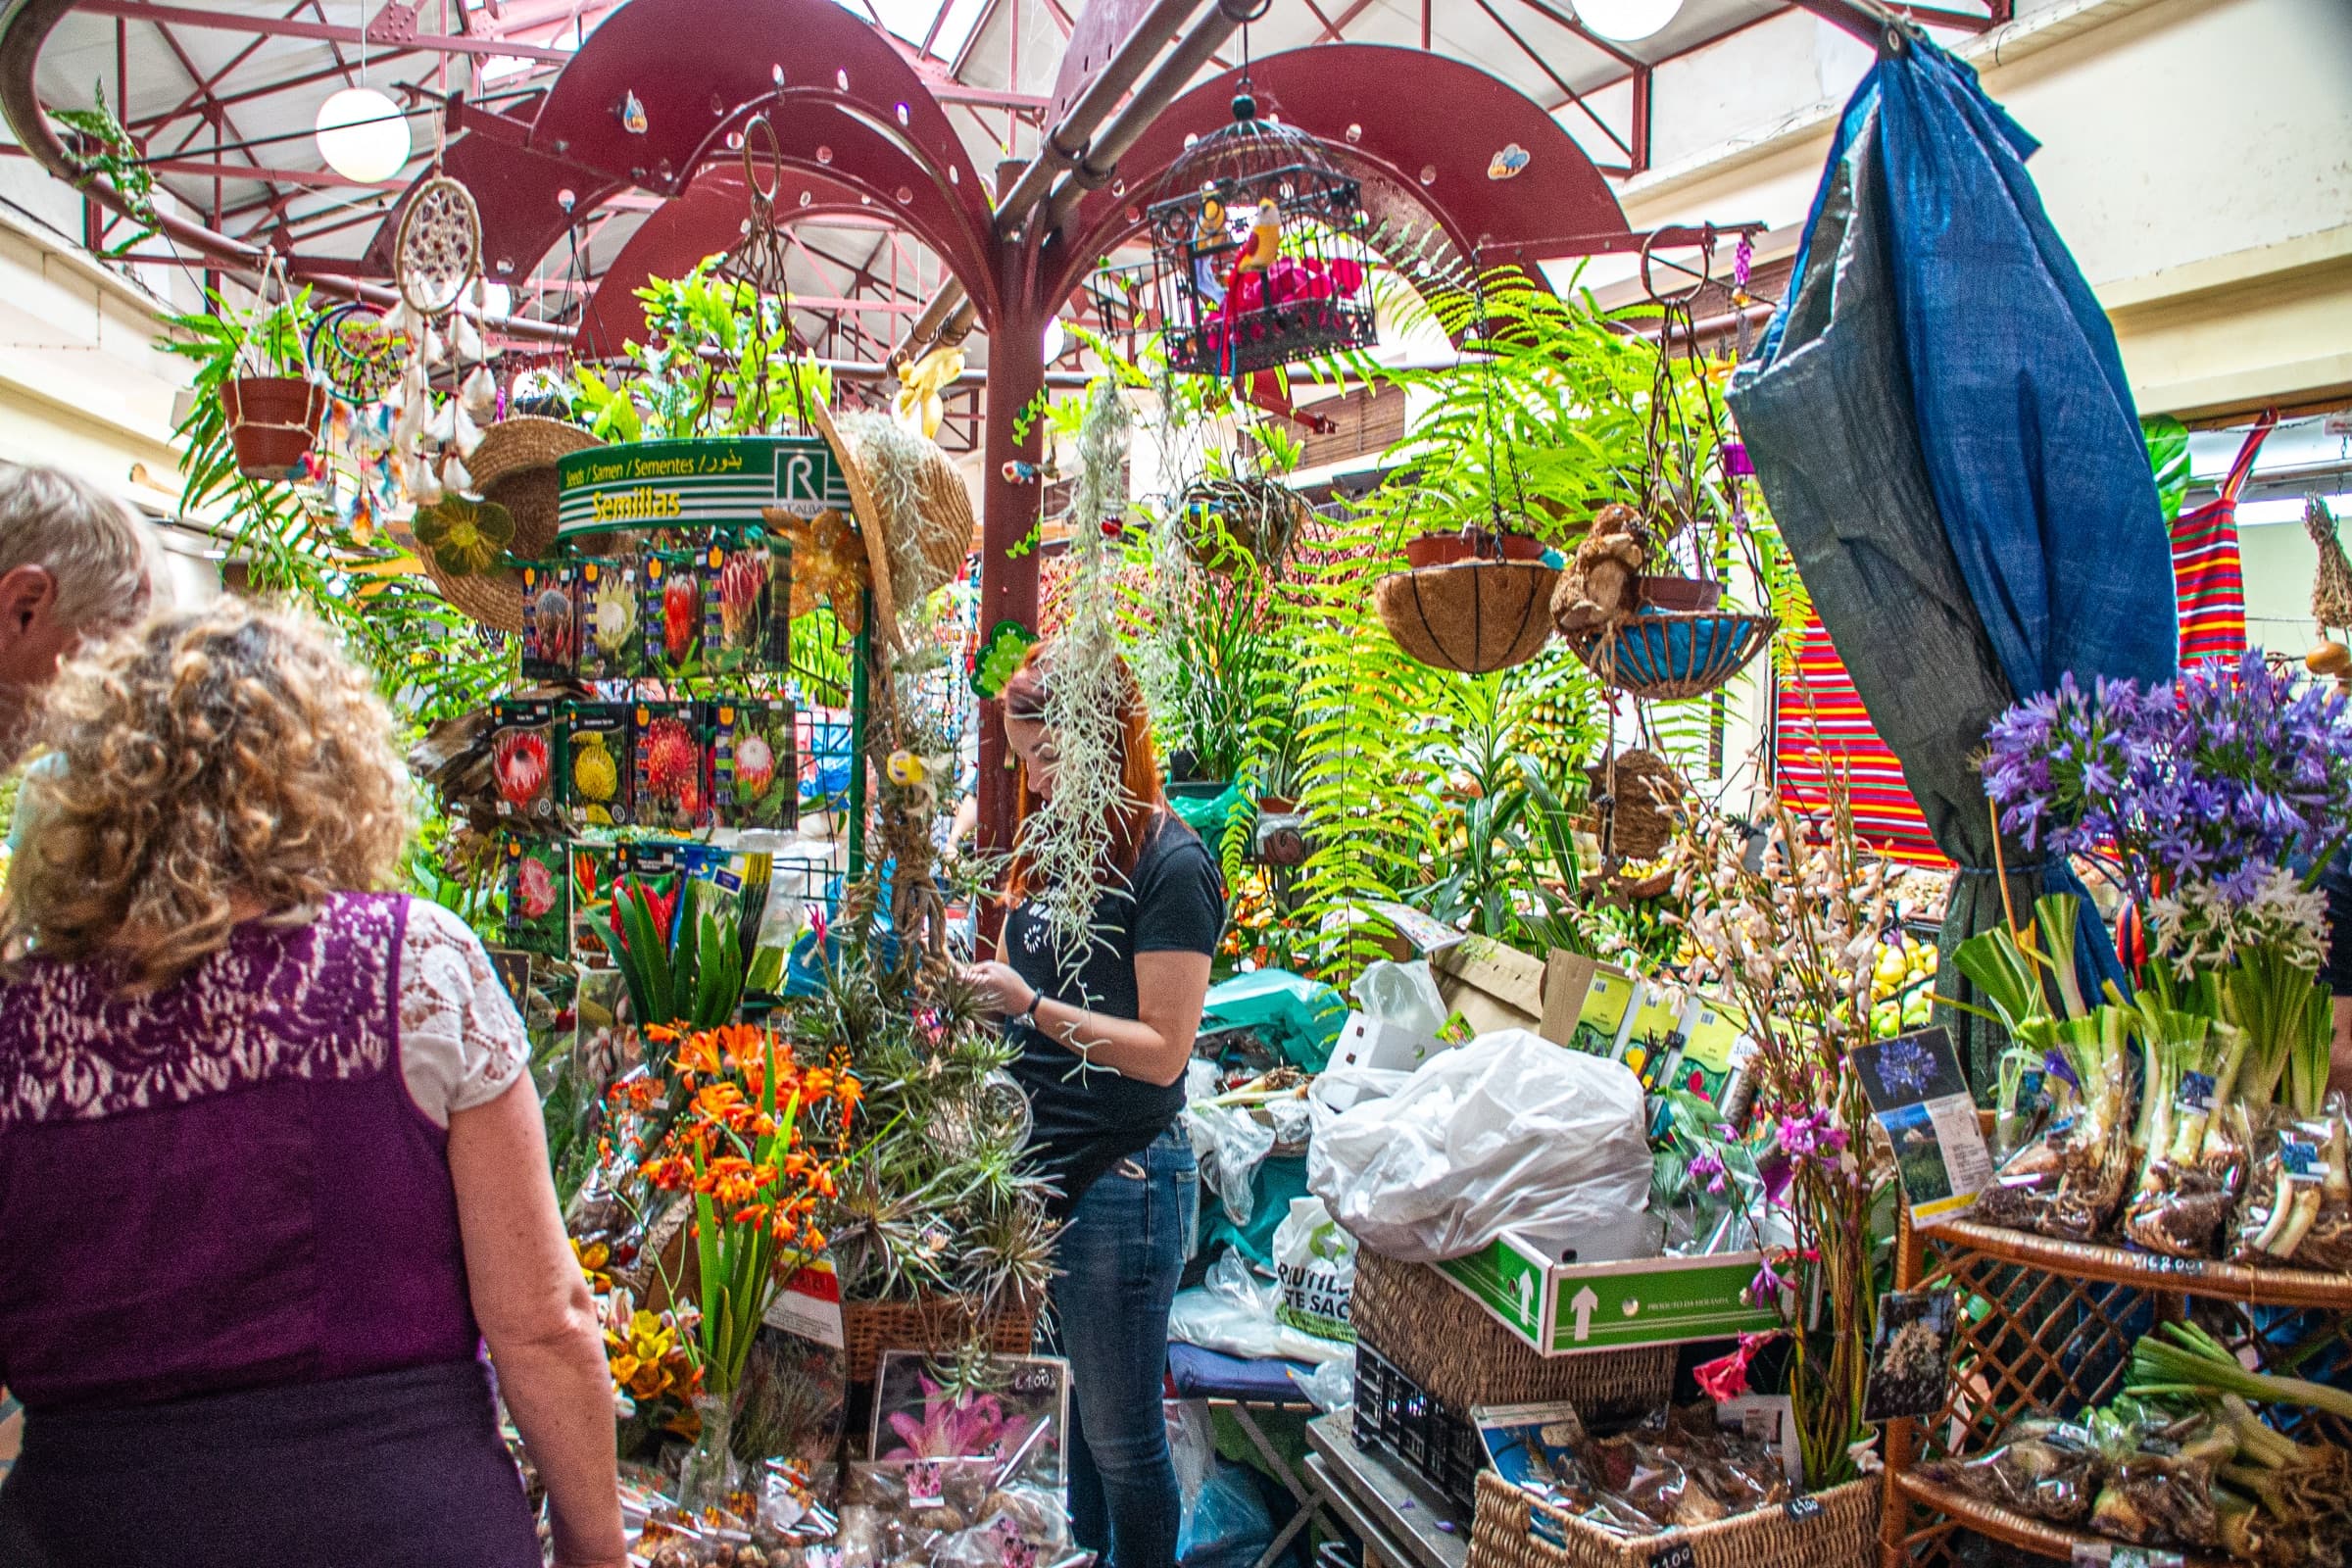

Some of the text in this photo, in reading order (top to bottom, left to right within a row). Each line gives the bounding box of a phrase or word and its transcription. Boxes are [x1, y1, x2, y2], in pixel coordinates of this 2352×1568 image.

[566, 469, 585, 488] Seeds
[592, 463, 623, 482] Samen
[634, 457, 695, 477] Sementes
[592, 486, 682, 523] Semillas
